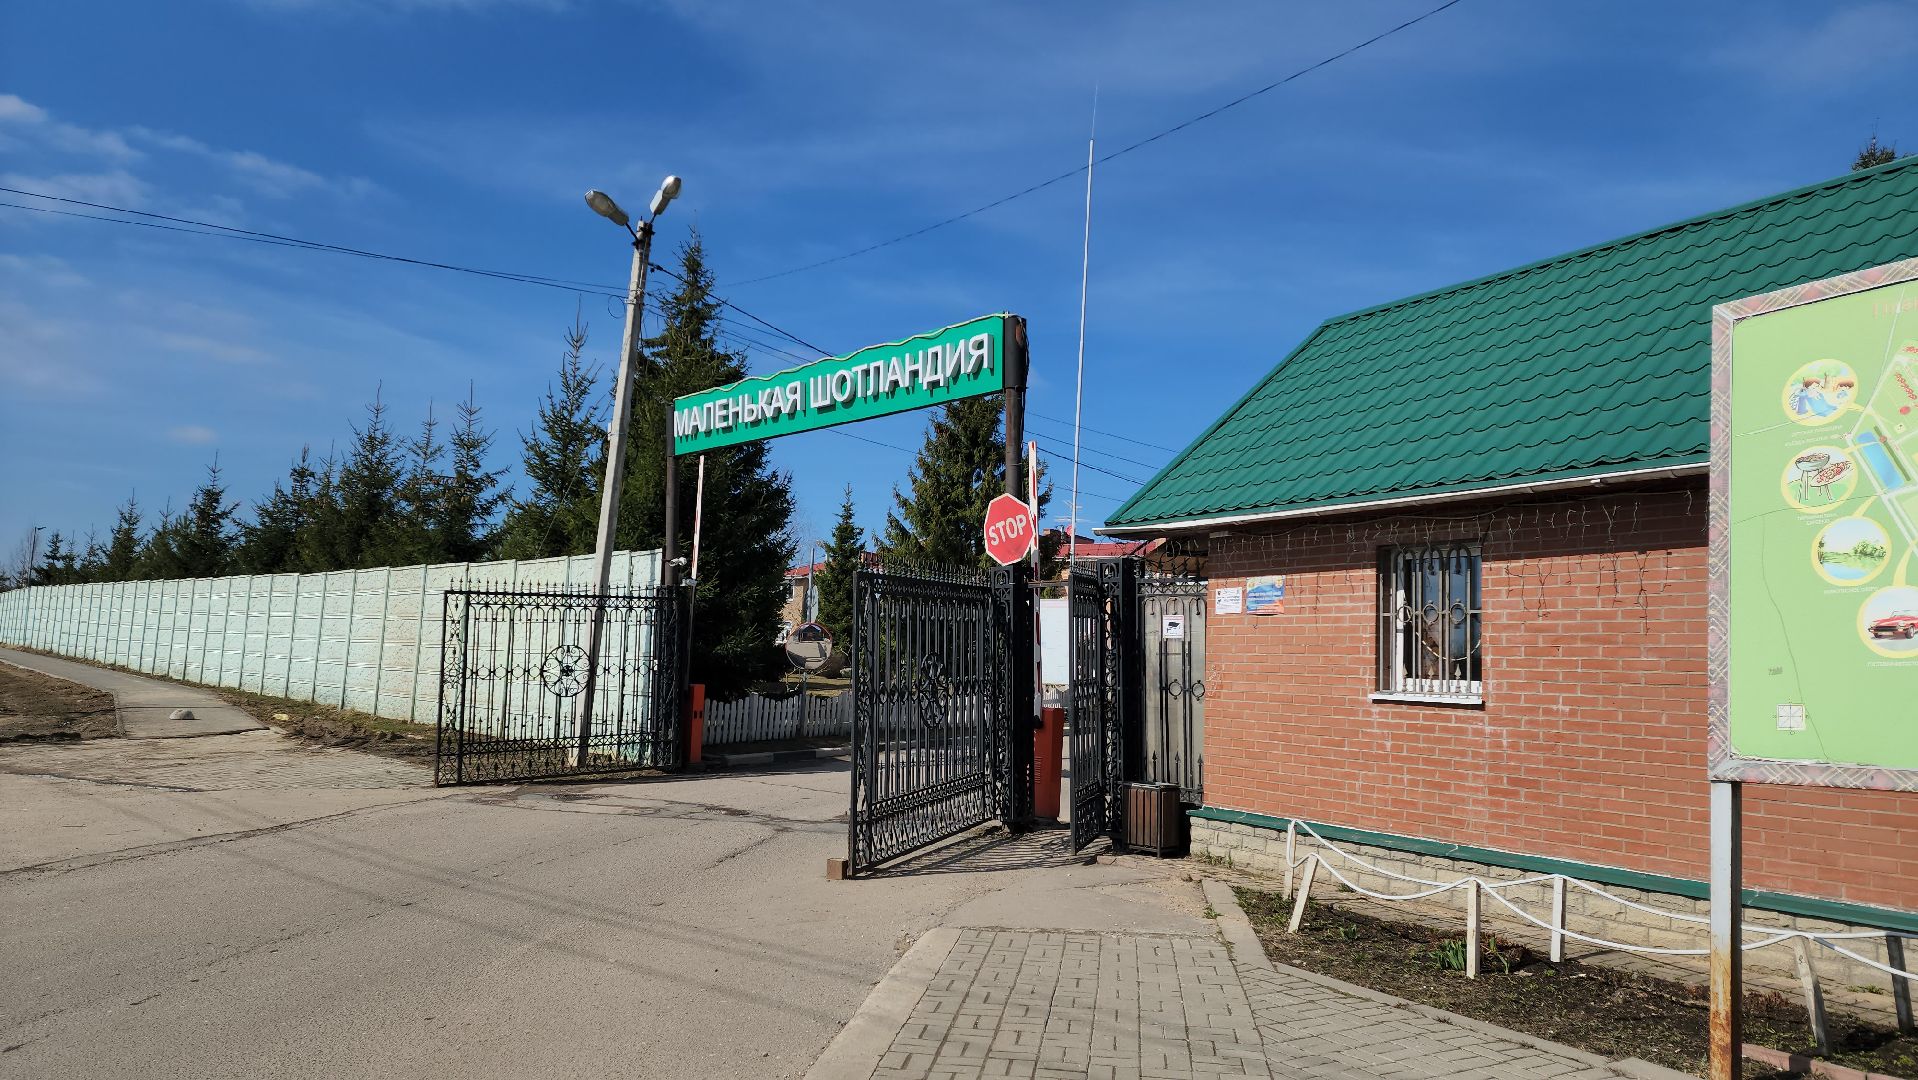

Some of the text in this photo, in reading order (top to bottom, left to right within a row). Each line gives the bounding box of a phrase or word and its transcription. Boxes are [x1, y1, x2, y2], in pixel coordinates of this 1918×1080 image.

[674, 333, 993, 438] МАЛЕНЬКАЯ ШОТЛАНДИЯ
[988, 514, 1028, 546] STOP
